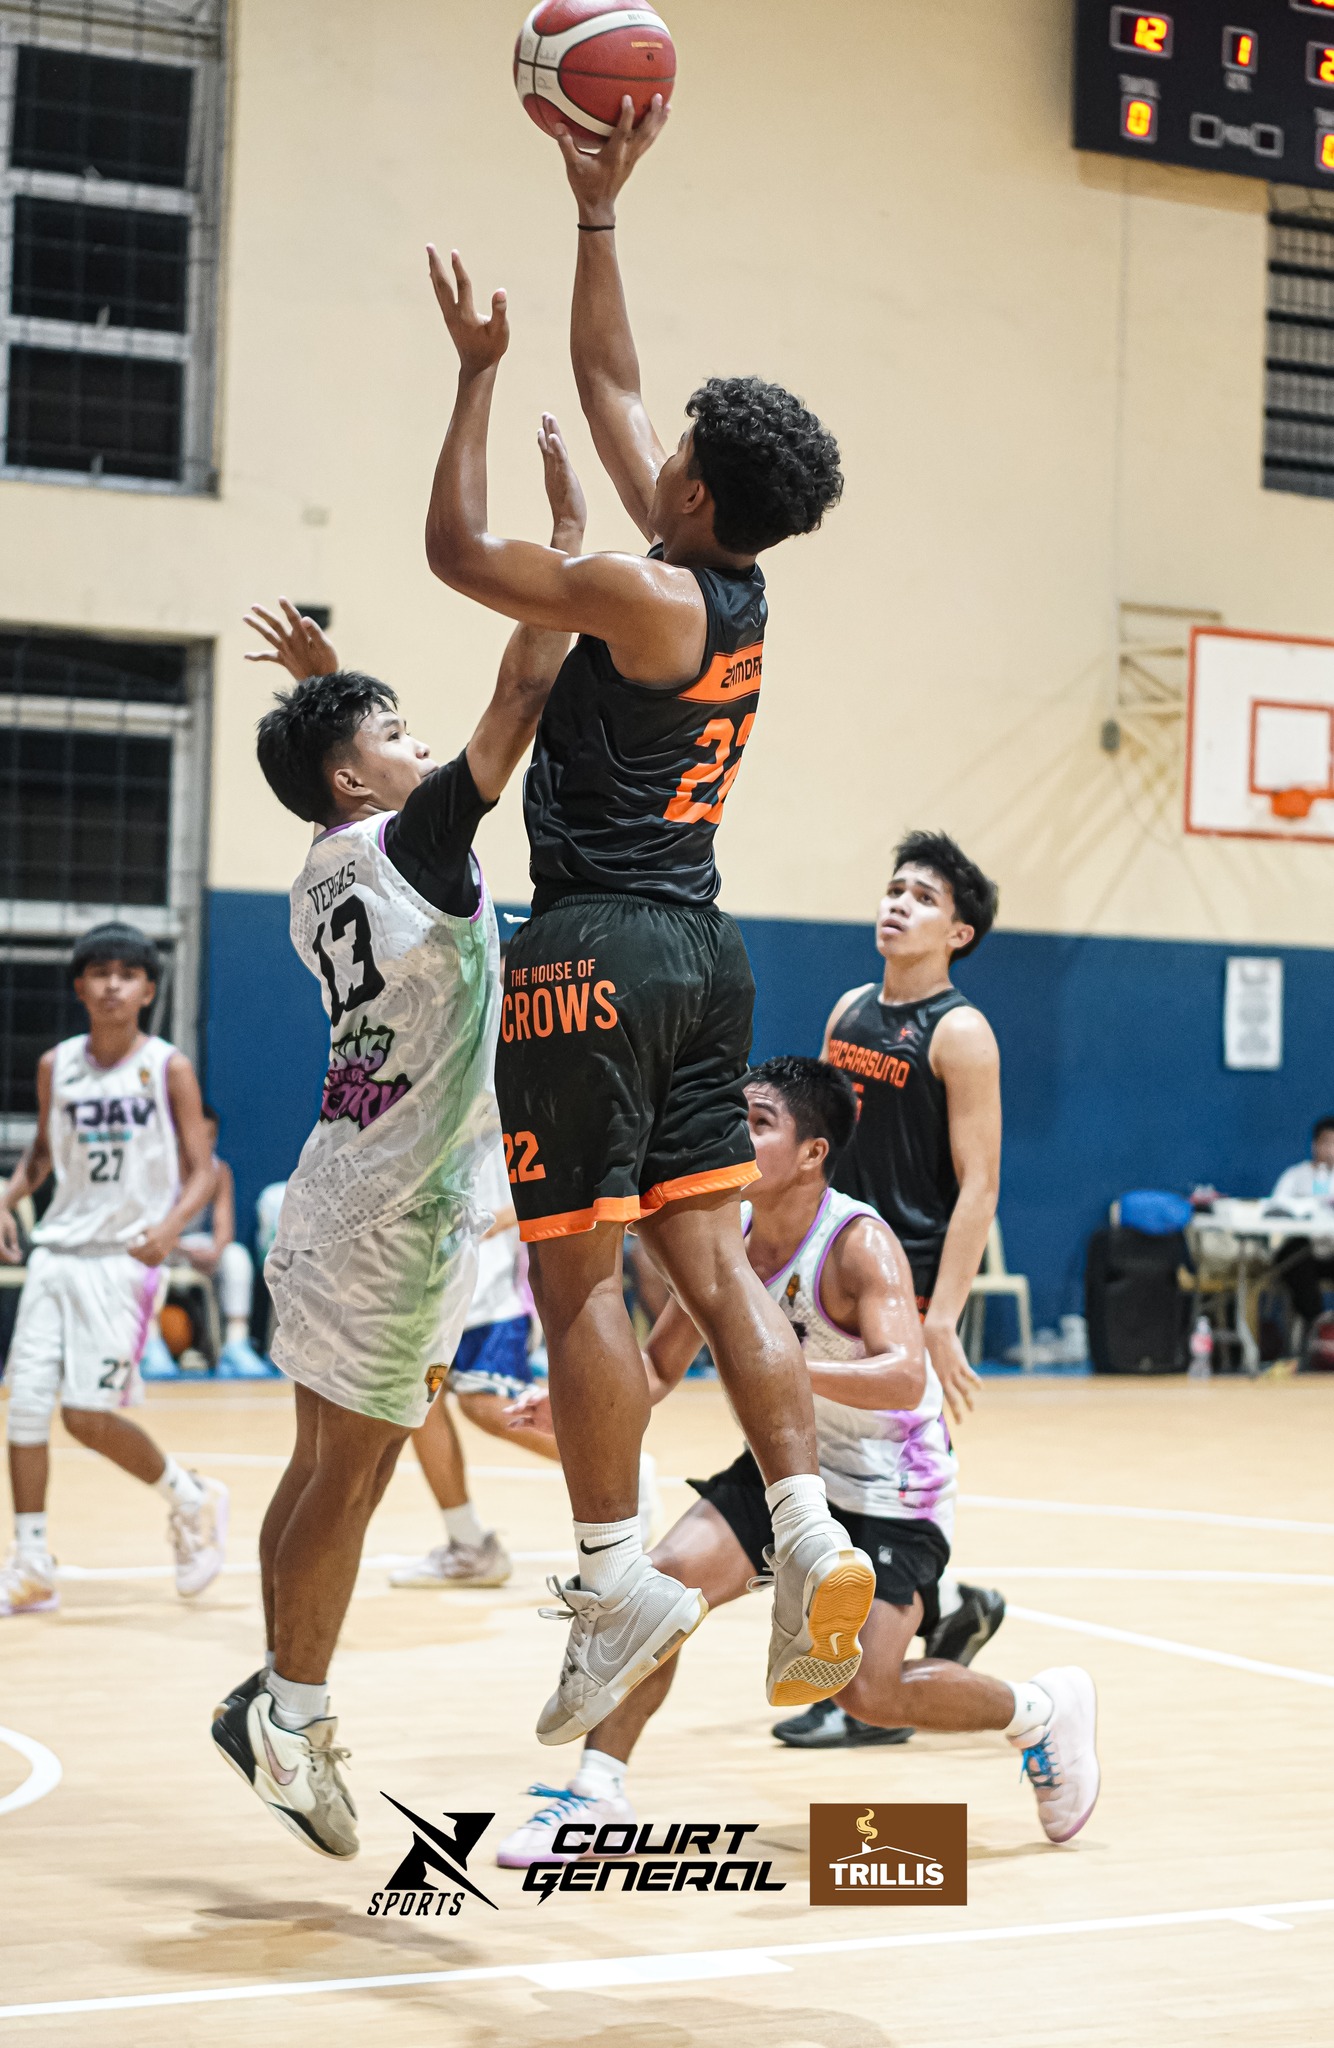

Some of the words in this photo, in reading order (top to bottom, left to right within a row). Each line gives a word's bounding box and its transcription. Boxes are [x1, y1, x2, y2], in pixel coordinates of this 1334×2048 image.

[1126, 100, 1152, 137] 0
[312, 894, 386, 1027] 13
[511, 968, 528, 987] THE
[531, 961, 572, 984] HOUSE
[577, 958, 596, 978] OF
[502, 979, 618, 1043] CROWS
[88, 1148, 124, 1182] 27
